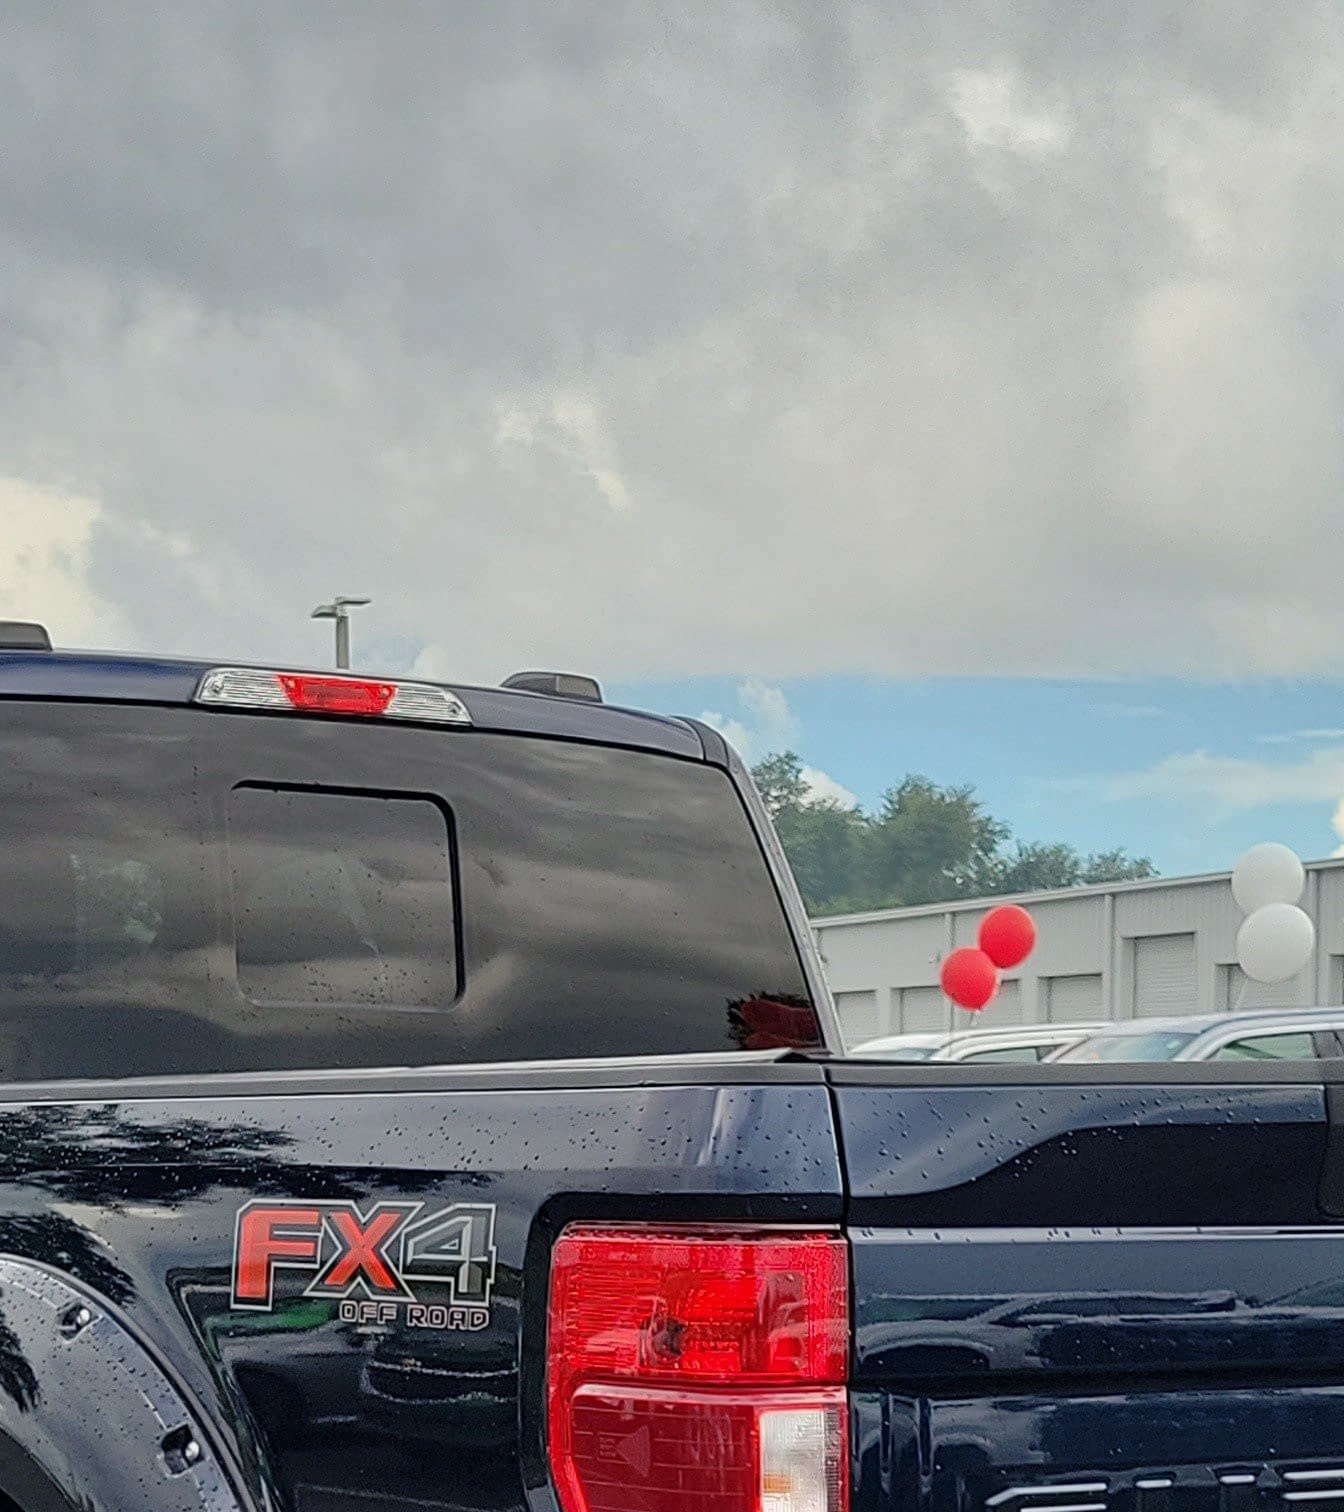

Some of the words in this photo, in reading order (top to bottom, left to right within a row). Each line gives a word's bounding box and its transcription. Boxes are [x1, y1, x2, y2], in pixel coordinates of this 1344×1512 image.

[229, 1198, 497, 1312] FX4
[339, 1299, 398, 1325] OFF
[407, 1305, 491, 1332] ROAD
